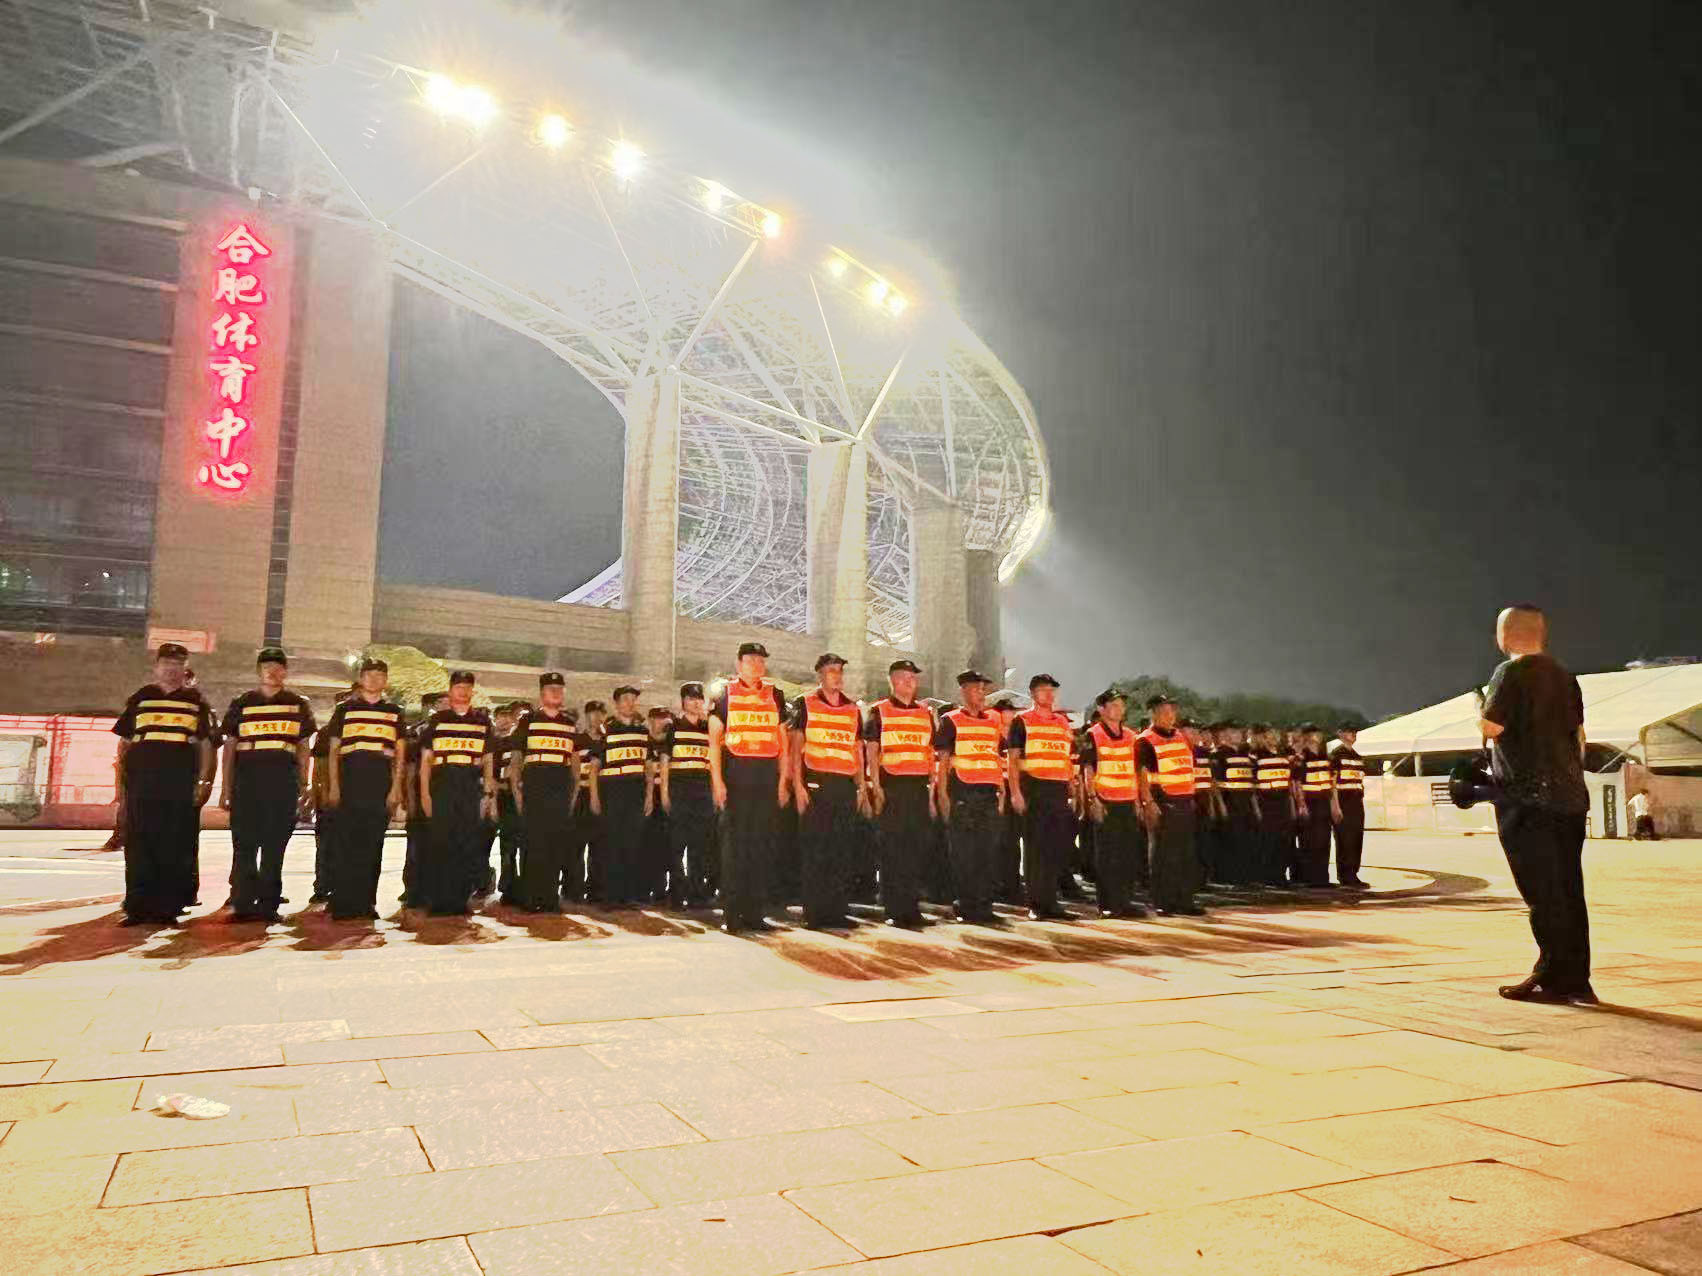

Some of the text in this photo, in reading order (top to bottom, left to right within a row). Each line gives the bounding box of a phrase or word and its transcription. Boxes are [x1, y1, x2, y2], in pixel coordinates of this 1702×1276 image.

[198, 224, 270, 490] 合肥体育中心
